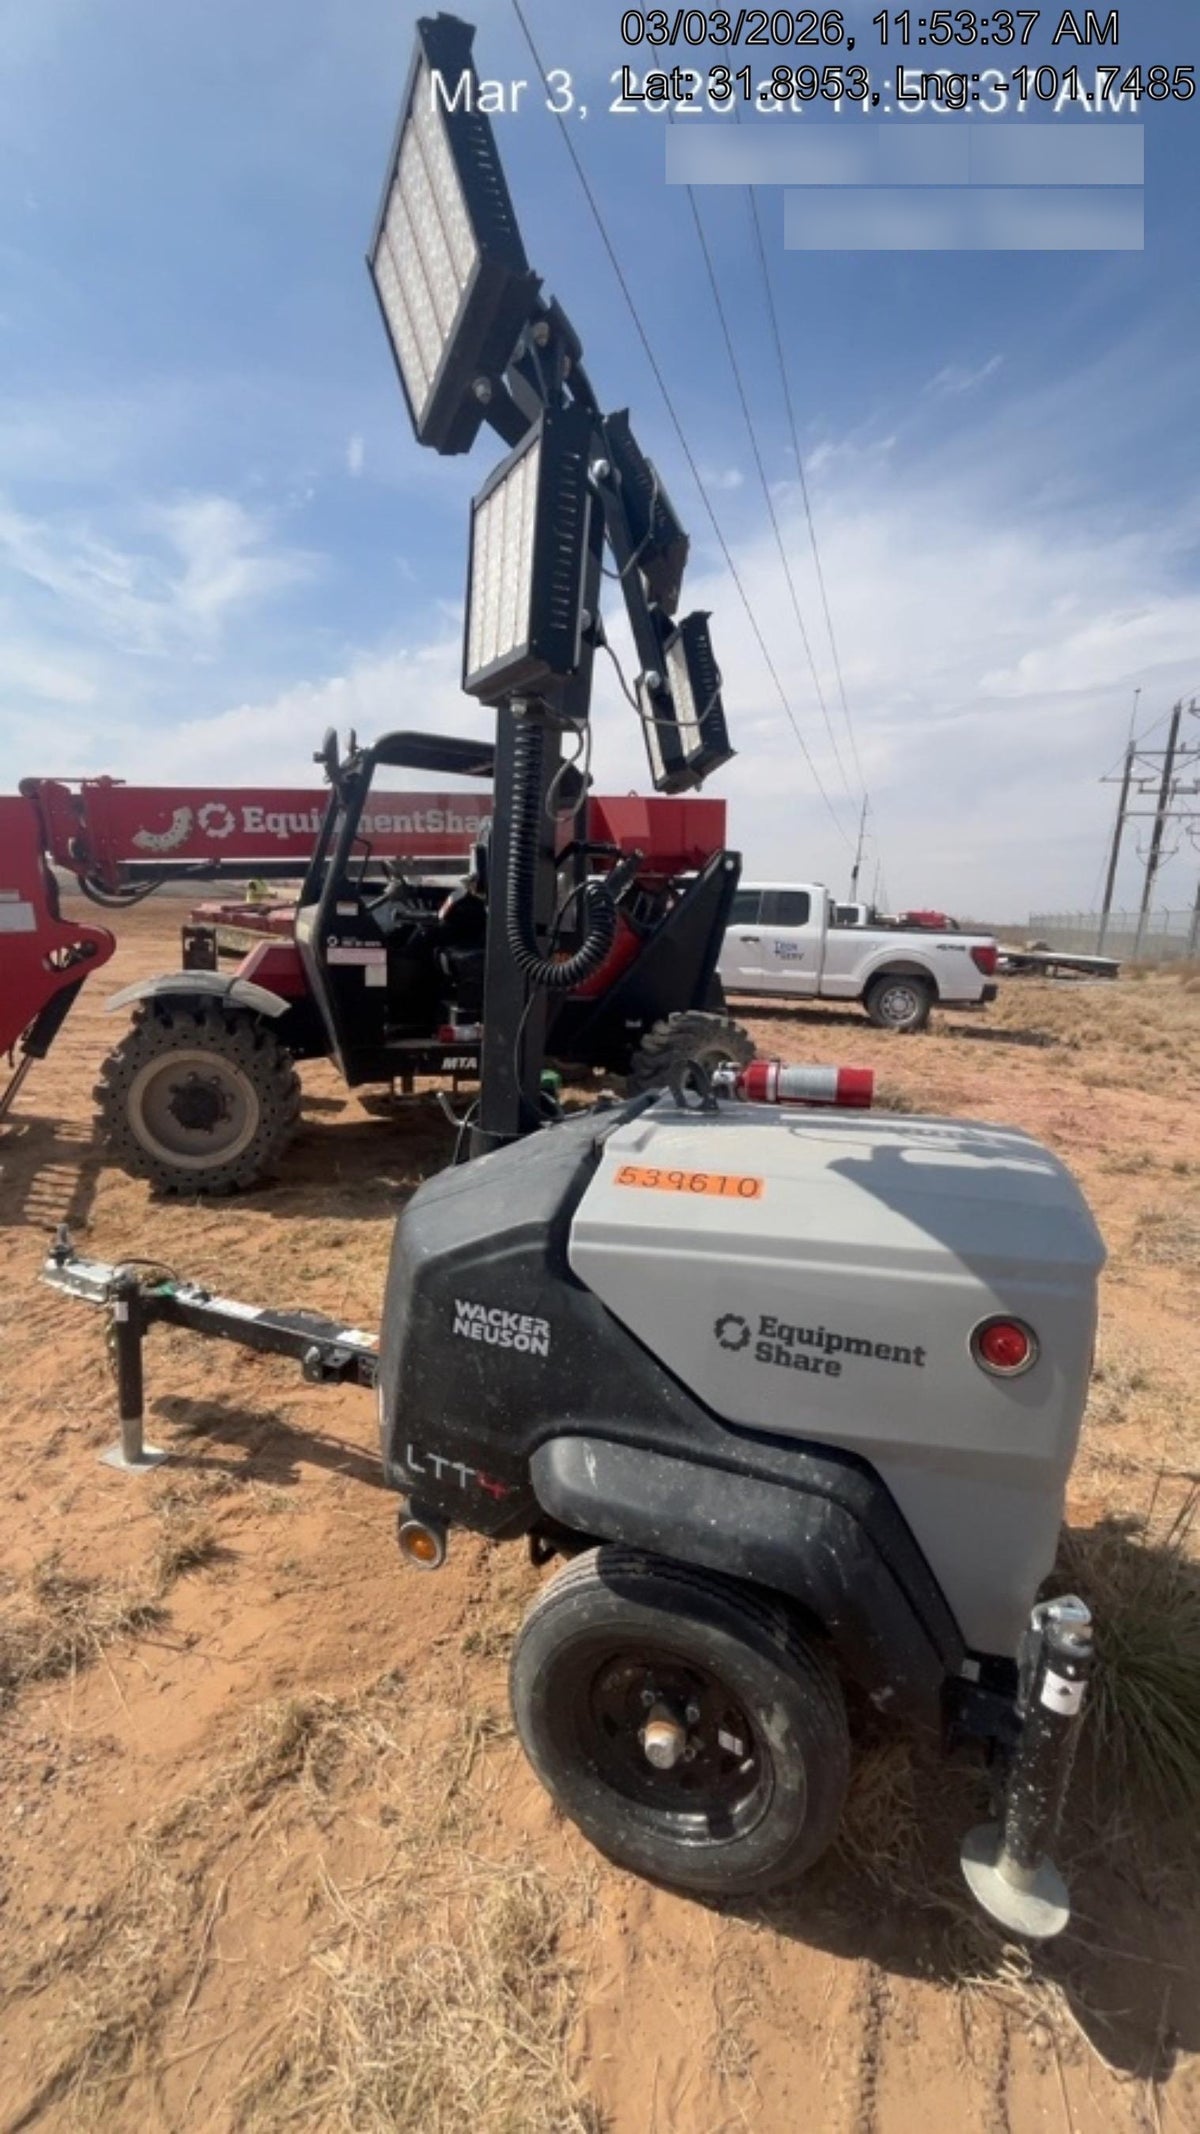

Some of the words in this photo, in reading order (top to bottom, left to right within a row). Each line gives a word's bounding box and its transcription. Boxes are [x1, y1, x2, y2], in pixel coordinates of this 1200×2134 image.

[617, 1165, 759, 1198] 539610
[452, 1316, 549, 1357] NEUSON
[454, 1298, 550, 1338] WACKER
[754, 1340, 842, 1377] Share
[758, 1314, 926, 1367] Equipment
